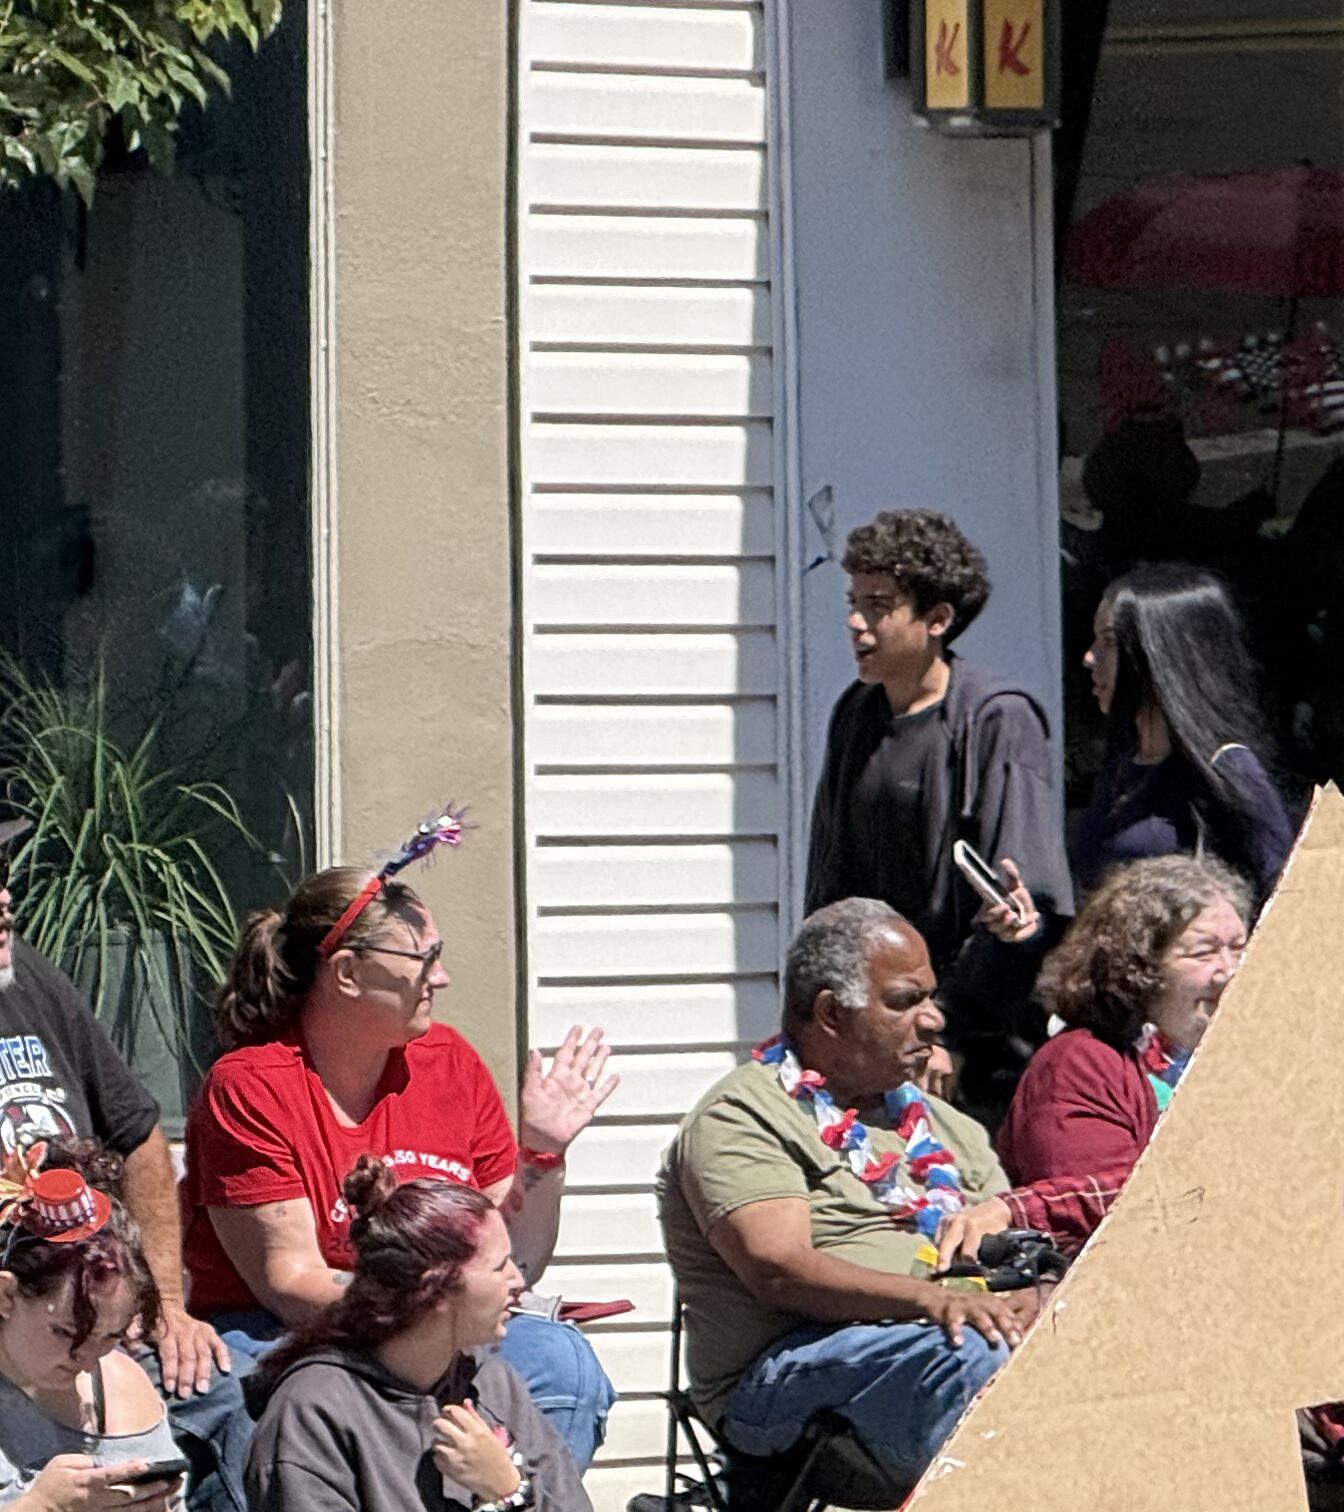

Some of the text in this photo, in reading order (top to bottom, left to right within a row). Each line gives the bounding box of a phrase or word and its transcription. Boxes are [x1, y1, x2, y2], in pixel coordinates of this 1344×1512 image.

[935, 18, 961, 76] K
[999, 18, 1031, 77] K
[0, 1035, 53, 1085] TER
[419, 1153, 471, 1182] YEARS
